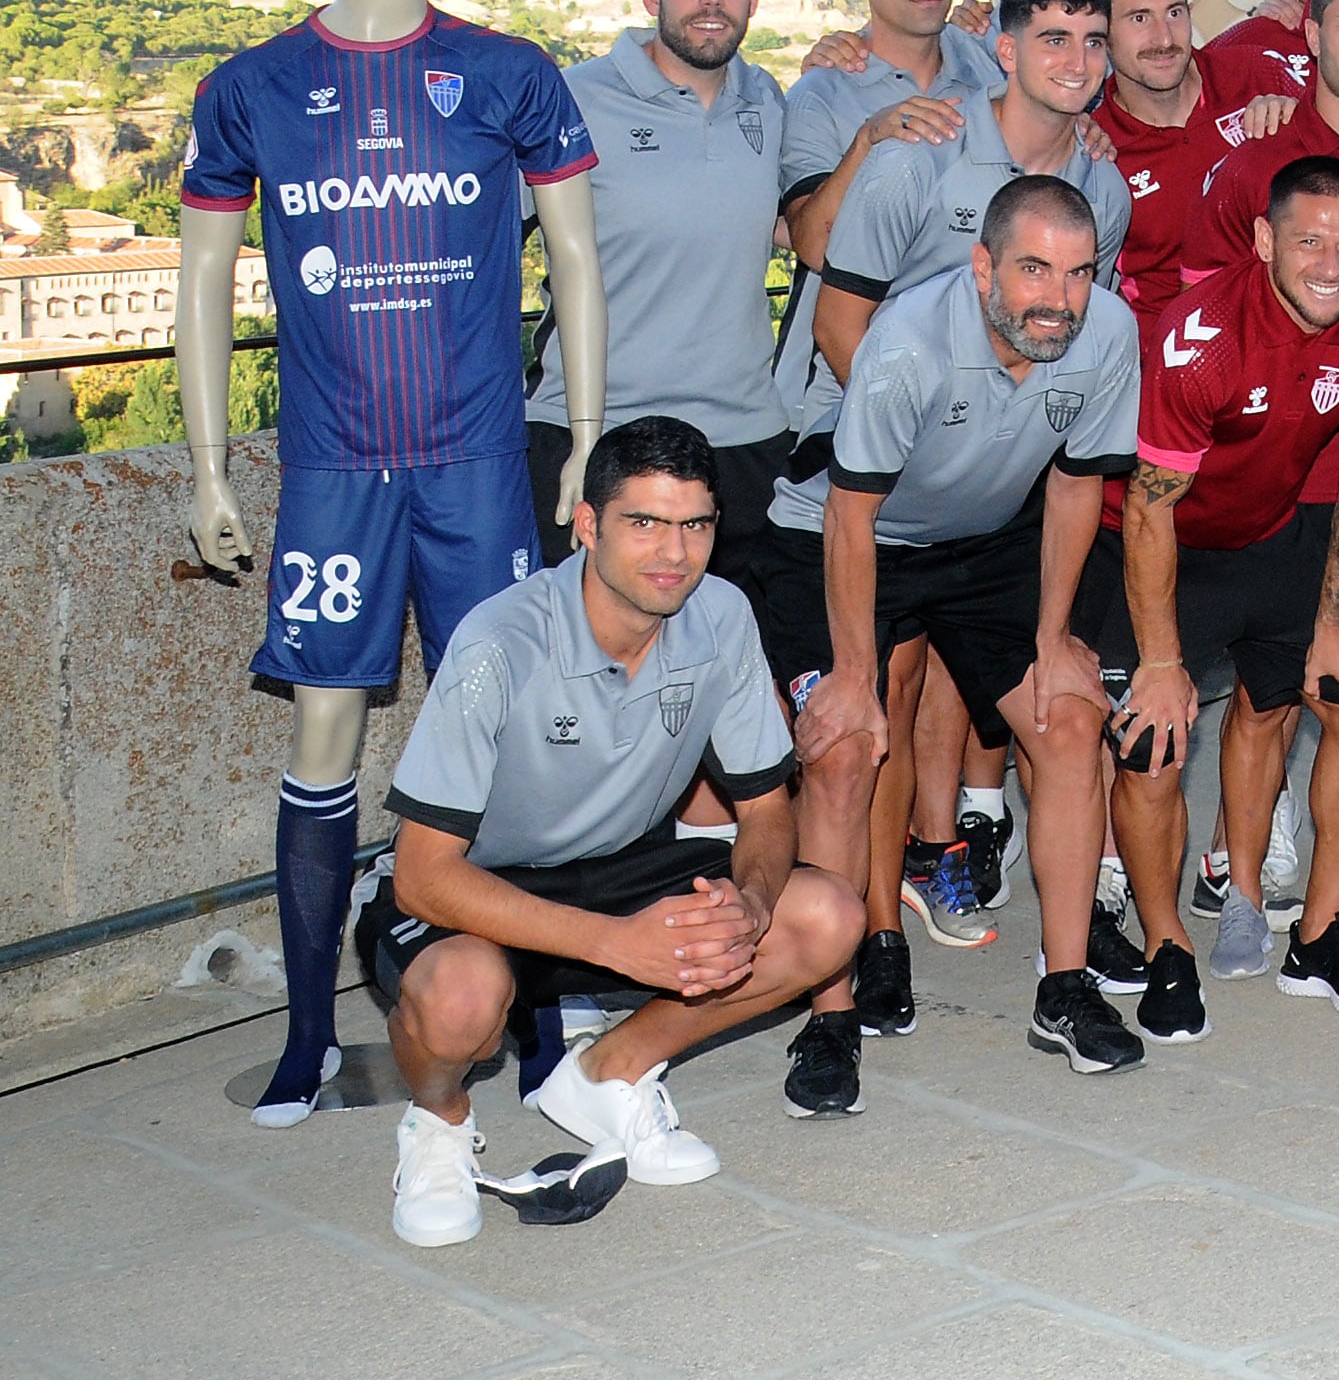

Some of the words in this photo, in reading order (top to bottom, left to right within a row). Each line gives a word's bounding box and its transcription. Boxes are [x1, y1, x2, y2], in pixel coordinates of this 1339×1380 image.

[357, 137, 404, 150] SEGOVIA
[340, 270, 475, 289] deportessegovia
[349, 297, 433, 312] www.imdsg.es
[281, 550, 363, 623] 28
